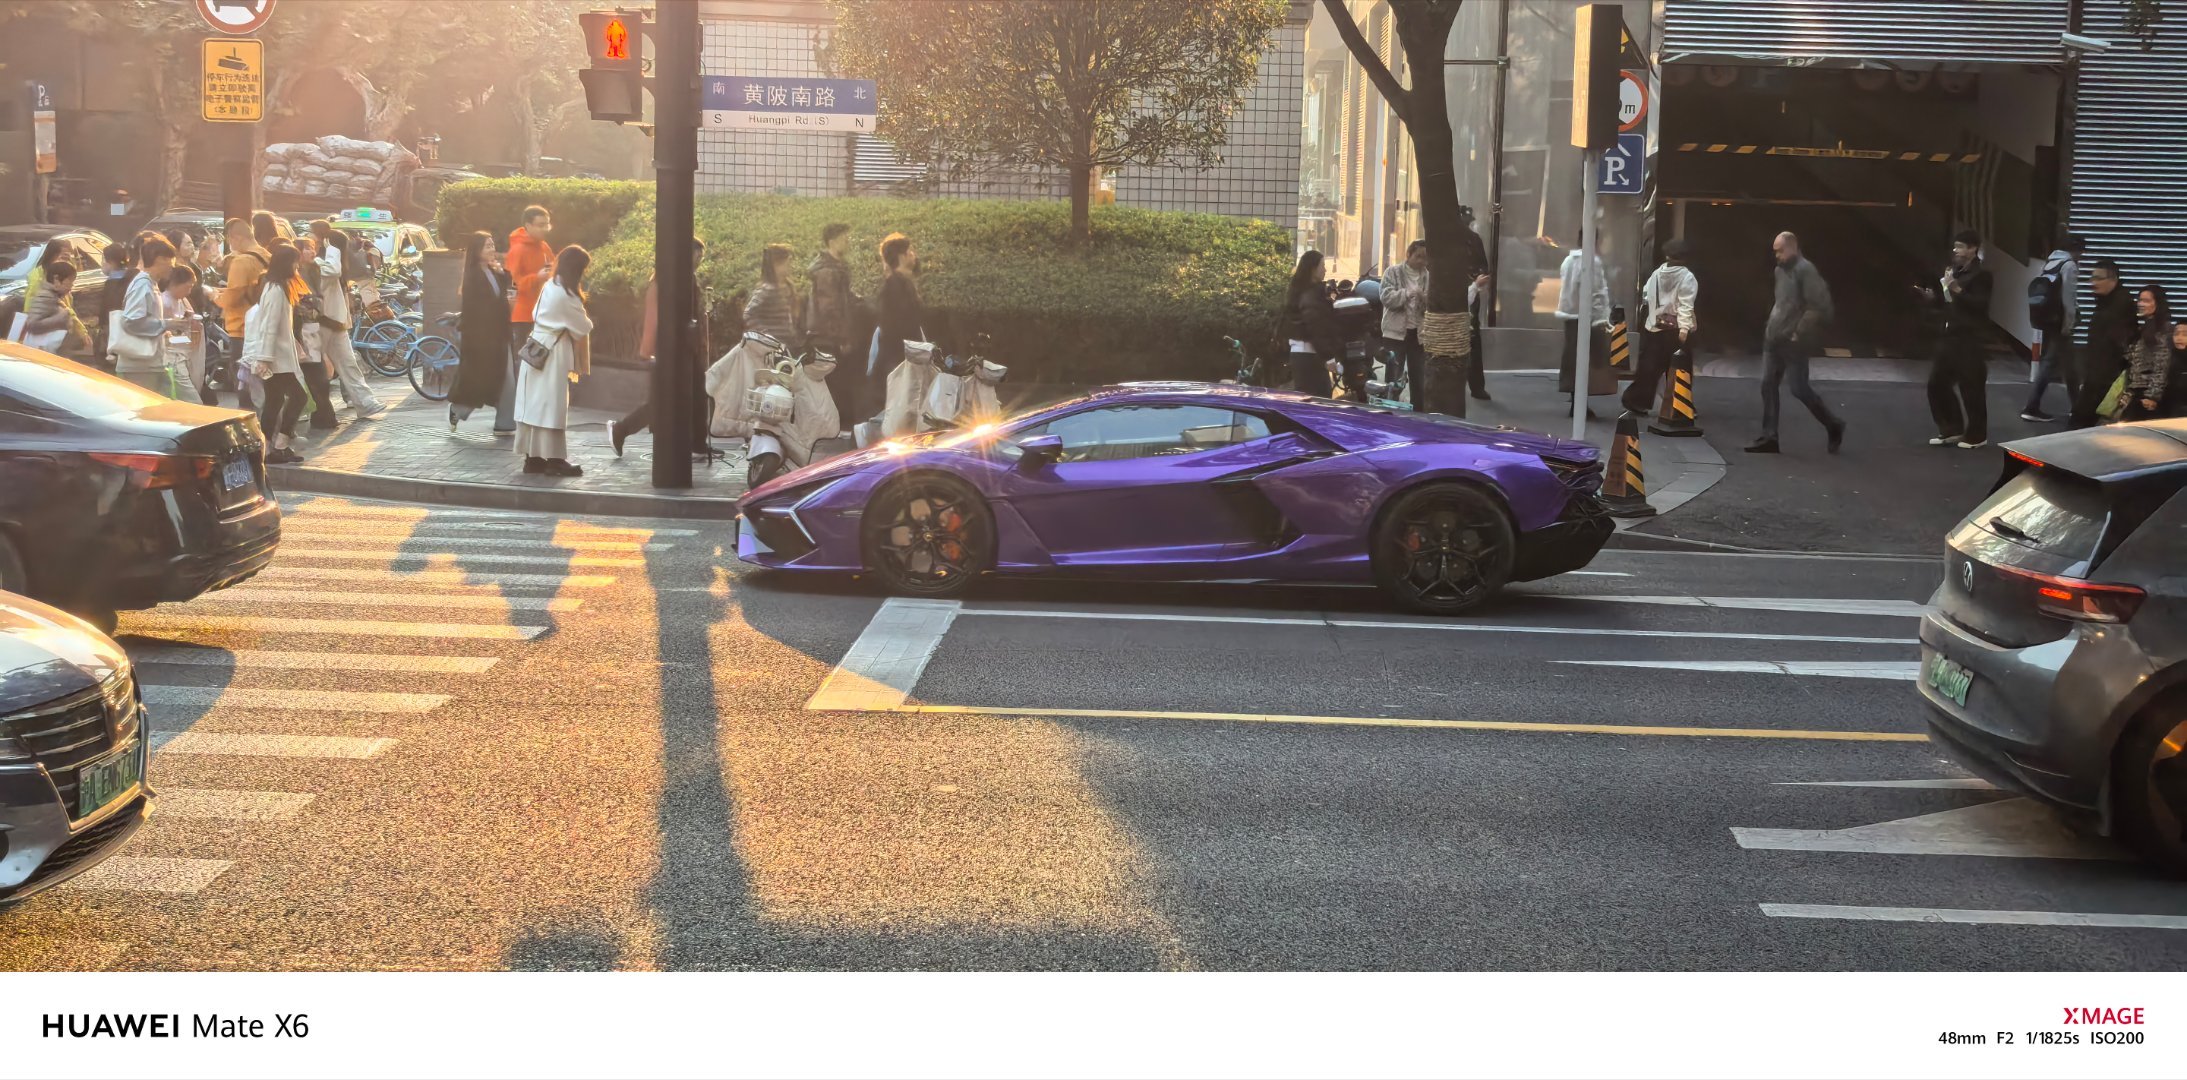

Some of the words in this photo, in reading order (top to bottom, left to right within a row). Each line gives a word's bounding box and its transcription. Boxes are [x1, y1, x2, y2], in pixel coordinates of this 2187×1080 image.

[743, 83, 836, 108] 黄陂南路
[854, 86, 867, 100] 北
[714, 114, 723, 124] S
[749, 115, 790, 126] Huangpi
[795, 116, 809, 125] Rd
[814, 117, 830, 126] (S)
[855, 118, 864, 128] N
